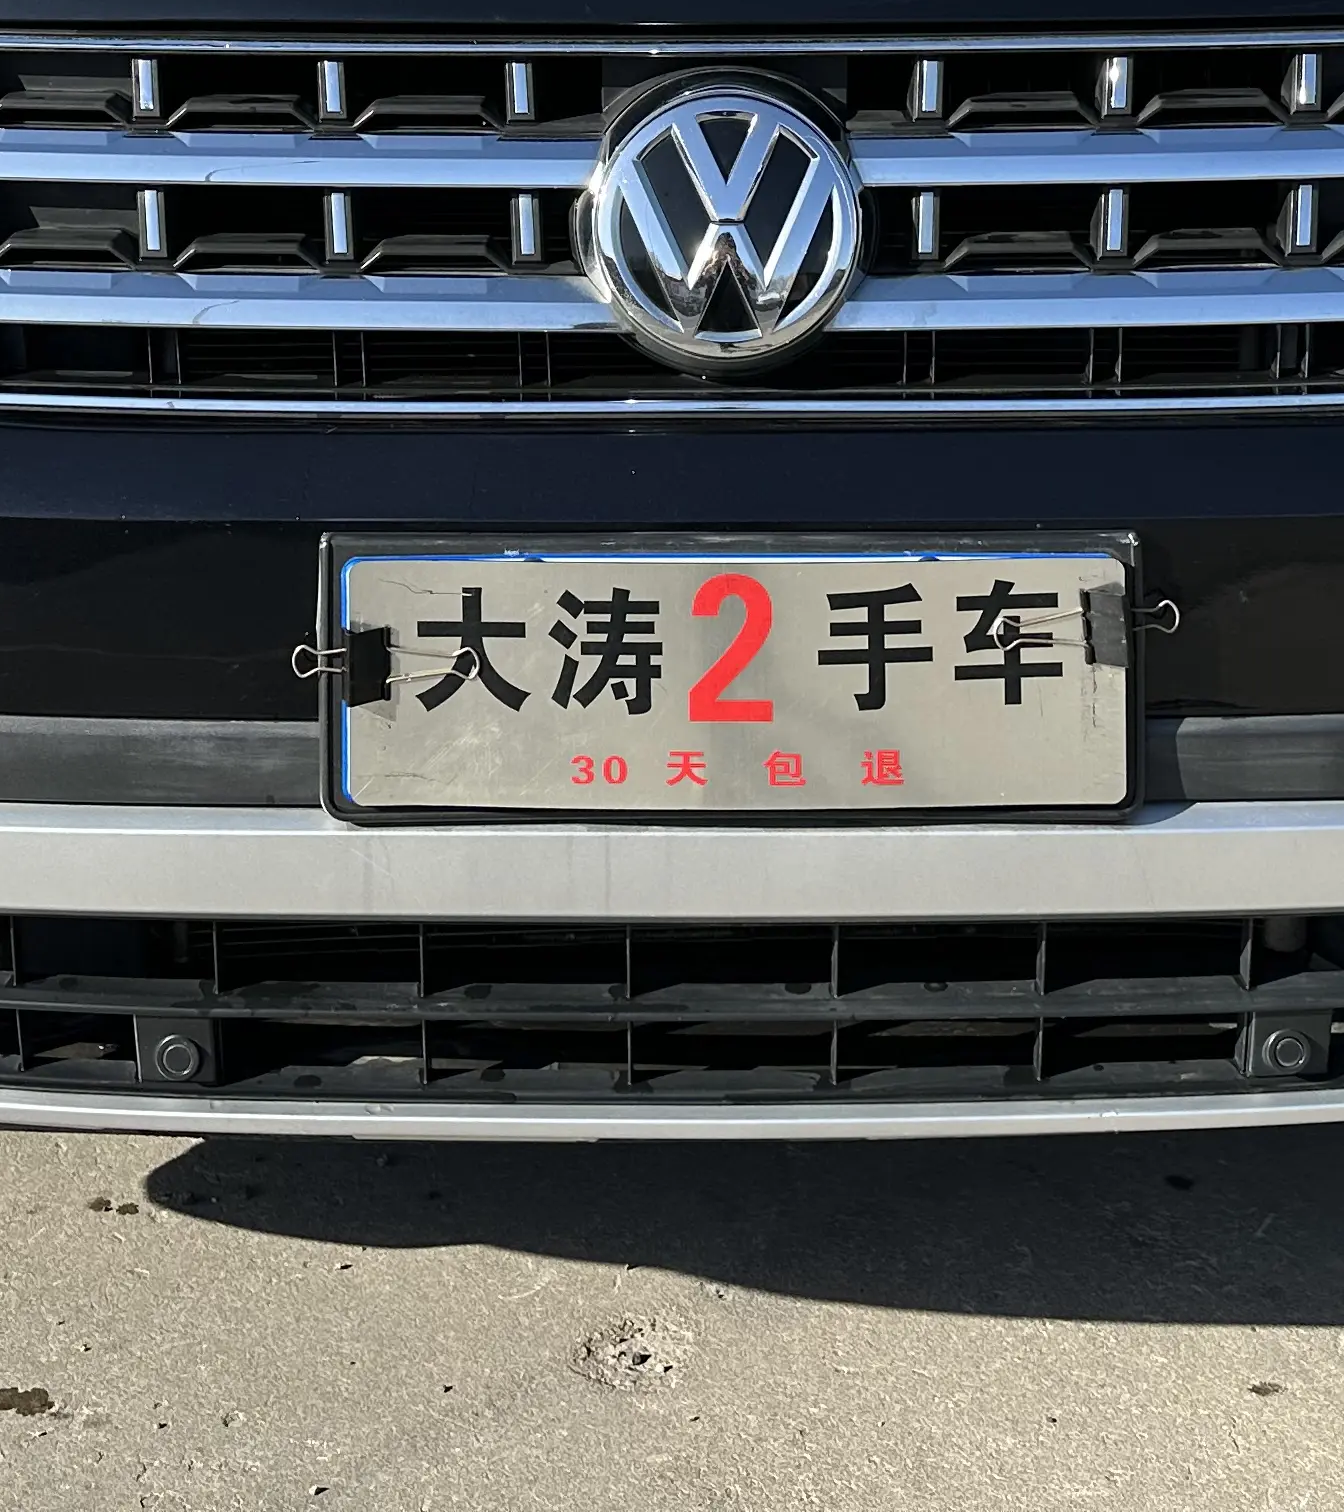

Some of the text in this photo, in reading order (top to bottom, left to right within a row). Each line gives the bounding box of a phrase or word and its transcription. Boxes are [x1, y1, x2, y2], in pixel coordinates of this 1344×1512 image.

[414, 572, 1065, 723] 大涛2手车
[569, 750, 906, 787] 30天包退
